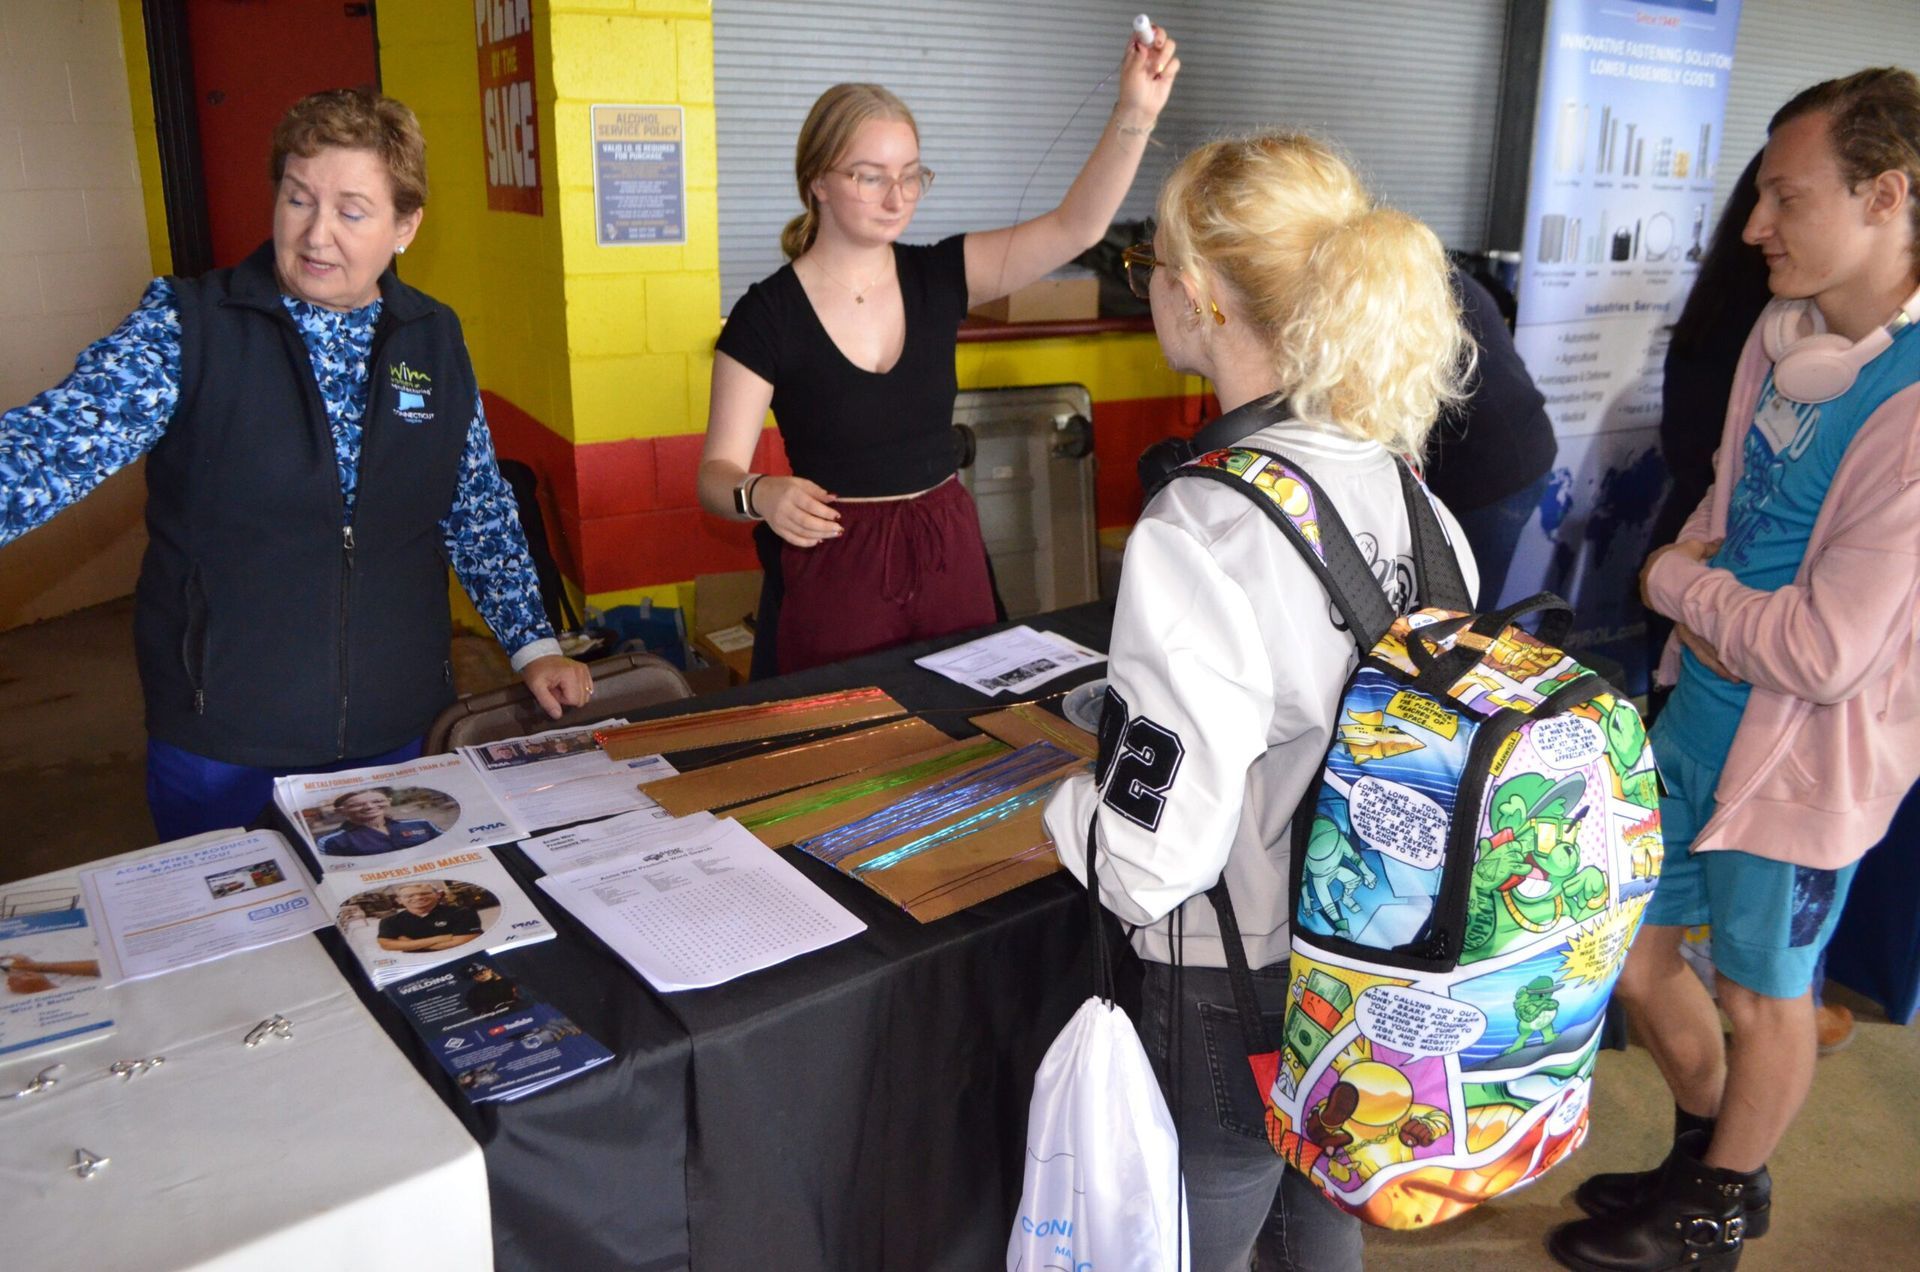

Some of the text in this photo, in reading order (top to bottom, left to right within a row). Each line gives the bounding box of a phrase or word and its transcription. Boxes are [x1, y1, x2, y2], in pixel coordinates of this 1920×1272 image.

[1560, 33, 1626, 55] INNOVATIVE
[1627, 41, 1682, 63] FASTENING
[1590, 58, 1716, 88] LOWER ASSEMBLY COSTS
[598, 124, 678, 136] SERVICE POLICY
[616, 113, 658, 124] ALCOHOL
[484, 81, 536, 187] SLICE
[602, 144, 622, 153] VALID
[635, 144, 641, 152] IS
[643, 143, 675, 153] REQUIRED
[1585, 301, 1671, 314] Industries Served
[1397, 705, 1430, 719] REACHES
[304, 776, 363, 790] METALFORMING
[372, 771, 395, 781] MUCH
[396, 767, 416, 777] MORE
[418, 764, 438, 773] THAN
[1358, 783, 1378, 794] LONG
[1382, 793, 1398, 804] HAVE
[1411, 806, 1447, 826] SKULKED
[1371, 782, 1384, 792] TOO
[1421, 803, 1437, 814] TOO
[1374, 796, 1387, 805] THE
[1391, 804, 1427, 824] SHADOWS
[468, 821, 507, 834] PMA
[1357, 802, 1394, 823] GALAXY...
[1399, 822, 1415, 830] BUT
[1360, 811, 1385, 824] MONEY
[1418, 836, 1433, 845] YOU
[1363, 799, 1376, 808] THE
[1380, 807, 1401, 818] EDGE
[1419, 823, 1432, 833] THE
[1353, 814, 1438, 854] WILL KNOW REVENGE
[1358, 822, 1372, 832] AND
[1376, 831, 1398, 843] KNOW
[1403, 843, 1421, 853] THAT
[115, 837, 260, 875] ACME WIRE PRODUCTS
[1363, 831, 1391, 847] BELONG
[1410, 853, 1422, 862] IT.
[150, 860, 195, 874] WANTS
[360, 852, 482, 882] SHAPERS AND MAKERS
[511, 919, 540, 930] PMA
[399, 973, 455, 994] WELDING
[1364, 992, 1393, 1006] MONEY
[1373, 988, 1389, 997] I'M
[1394, 995, 1431, 1010] CALLING
[1367, 1008, 1411, 1026] CLAIMING
[1370, 1002, 1387, 1011] YOU
[1392, 1009, 1426, 1023] PARADE
[1372, 1025, 1394, 1035] HIGH
[1398, 1032, 1416, 1041] AND
[1376, 1033, 1396, 1044] WELL
